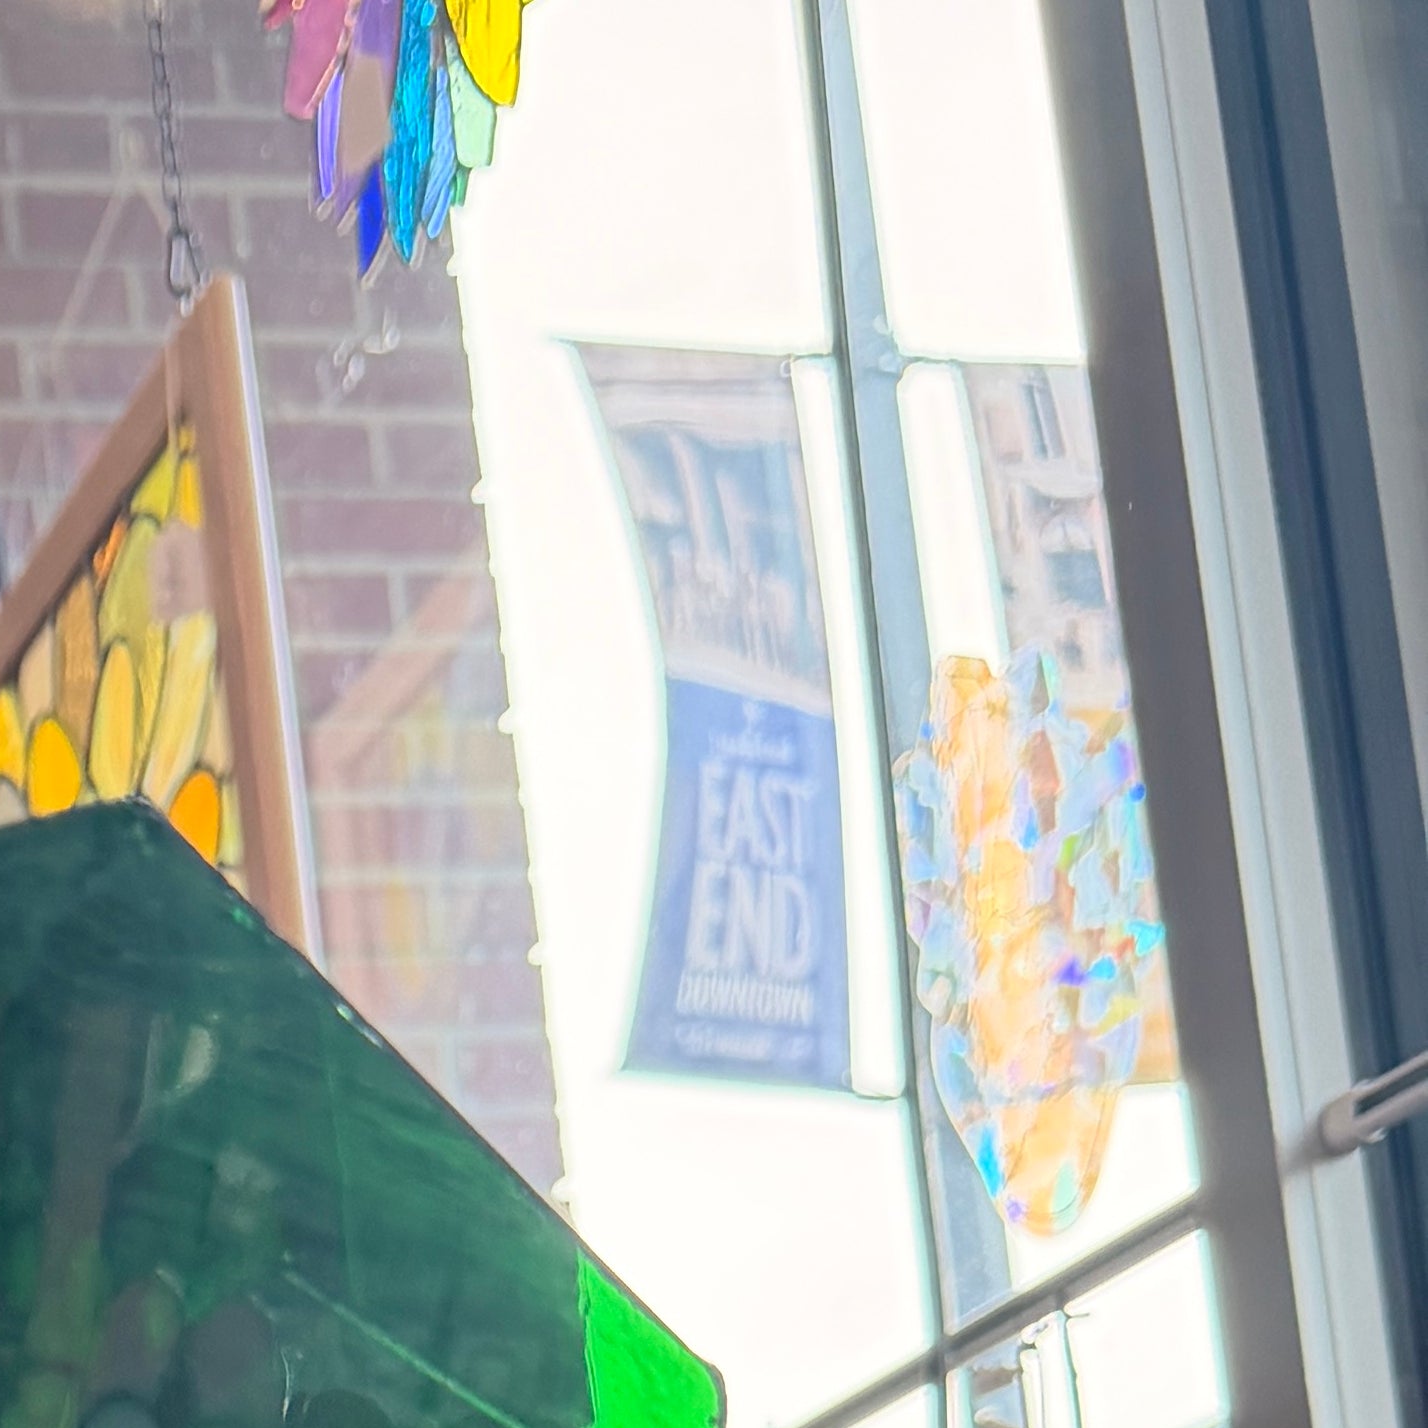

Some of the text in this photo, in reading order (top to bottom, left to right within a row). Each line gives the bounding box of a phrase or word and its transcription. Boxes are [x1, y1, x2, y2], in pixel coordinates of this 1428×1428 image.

[697, 757, 819, 871] EAST
[685, 859, 818, 980] END
[676, 970, 814, 1028] DOWNTOWN
